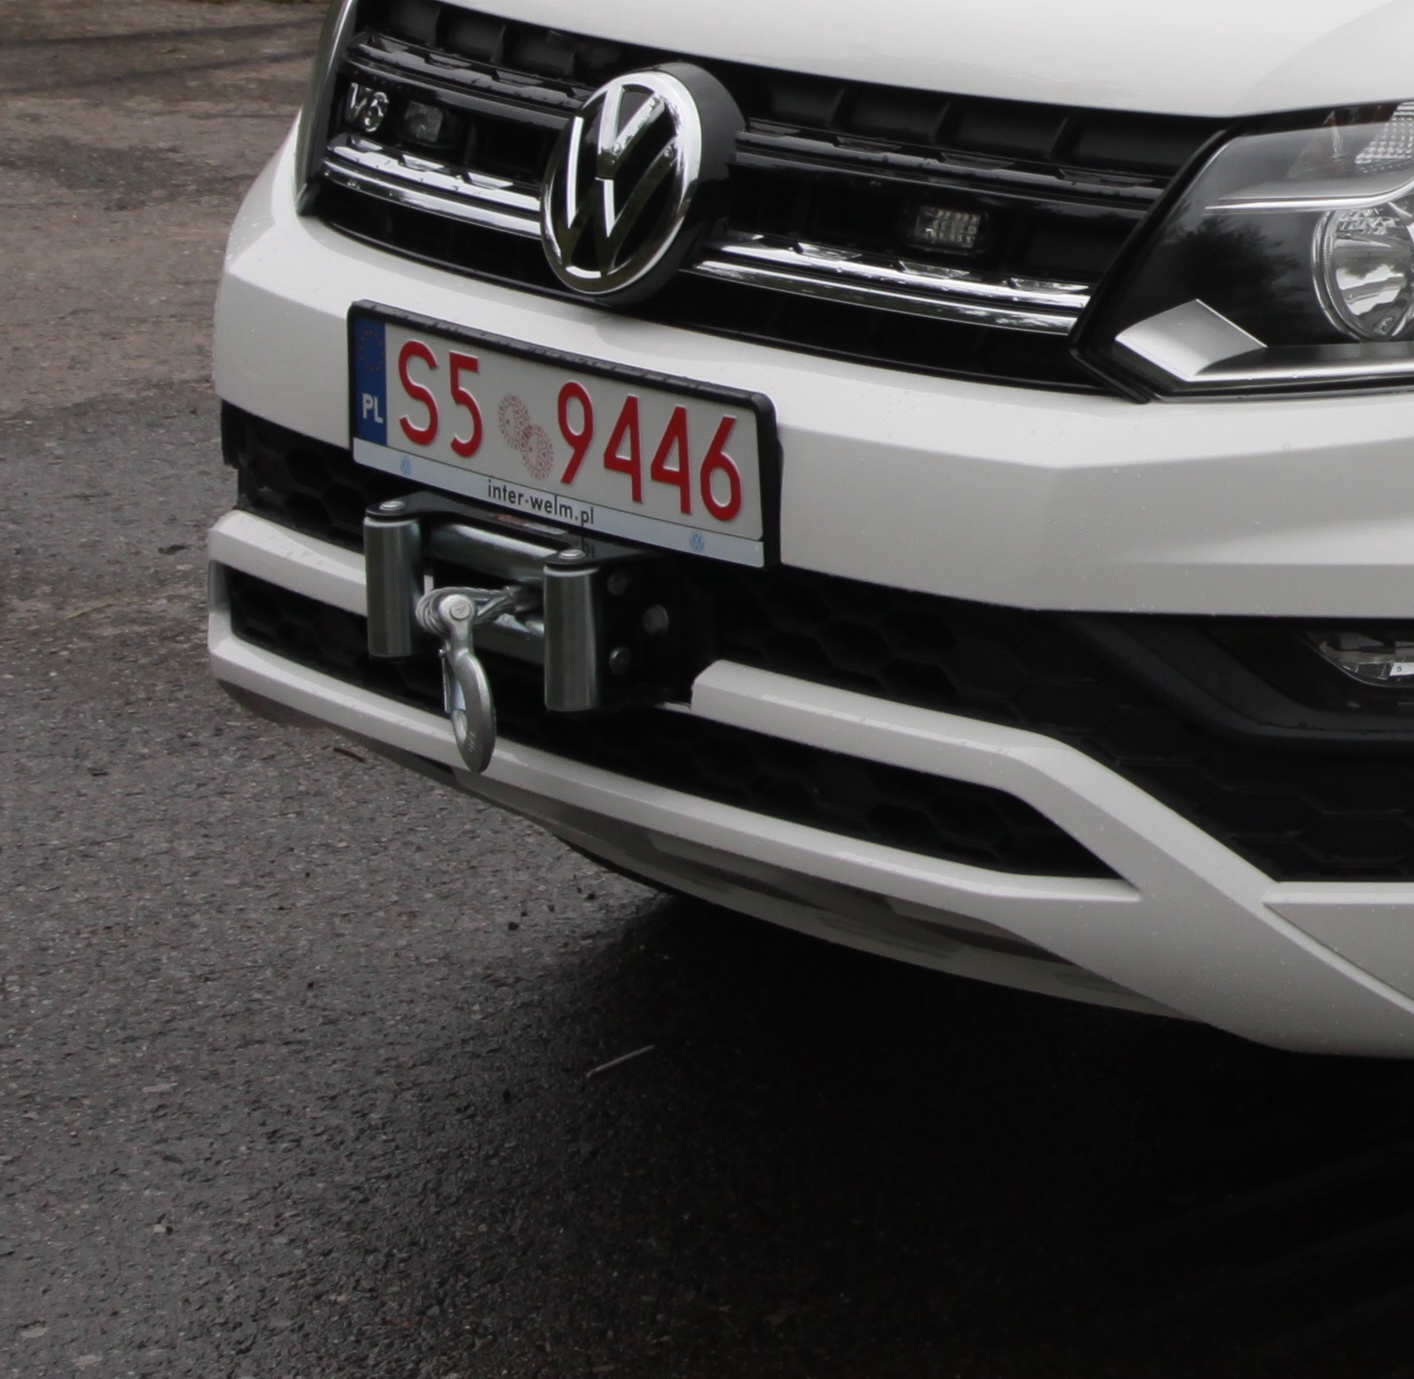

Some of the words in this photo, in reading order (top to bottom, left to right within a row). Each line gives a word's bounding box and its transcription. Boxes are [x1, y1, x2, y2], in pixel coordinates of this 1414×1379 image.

[361, 392, 384, 423] PL
[398, 339, 484, 458] S5
[556, 380, 742, 522] 9446
[487, 479, 594, 526] inter-welm.pl
